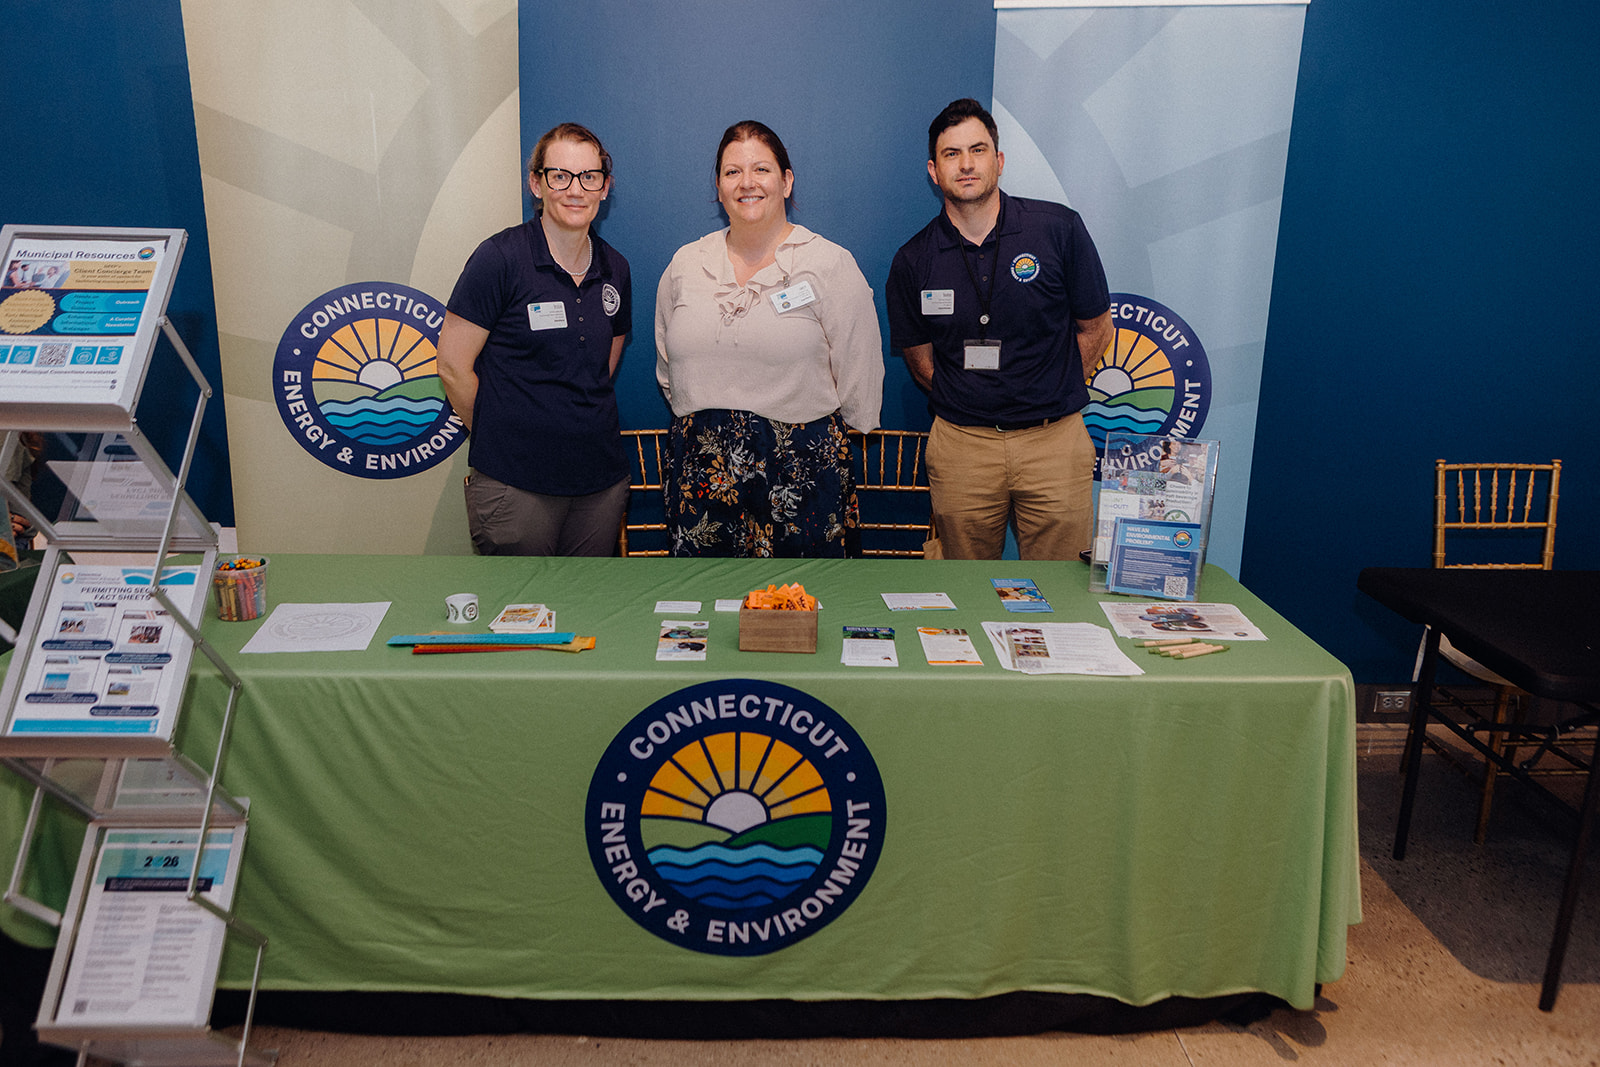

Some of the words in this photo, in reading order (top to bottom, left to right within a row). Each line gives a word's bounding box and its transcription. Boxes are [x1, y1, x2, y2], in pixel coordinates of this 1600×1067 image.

[15, 250, 73, 261] Municipal
[75, 250, 136, 260] Resources
[300, 292, 444, 340] CONNECTICU
[1111, 302, 1190, 352] ECTICUT
[284, 370, 336, 450] ENERGY
[336, 446, 354, 464] &
[366, 408, 464, 470] ENVIRONM
[1126, 532, 1171, 541] ENVIRONMENTAL
[629, 694, 850, 759] CONNECTICUT
[601, 802, 667, 914] ENERGY
[666, 908, 690, 934] &
[706, 800, 871, 944] ENVIRONMENT
